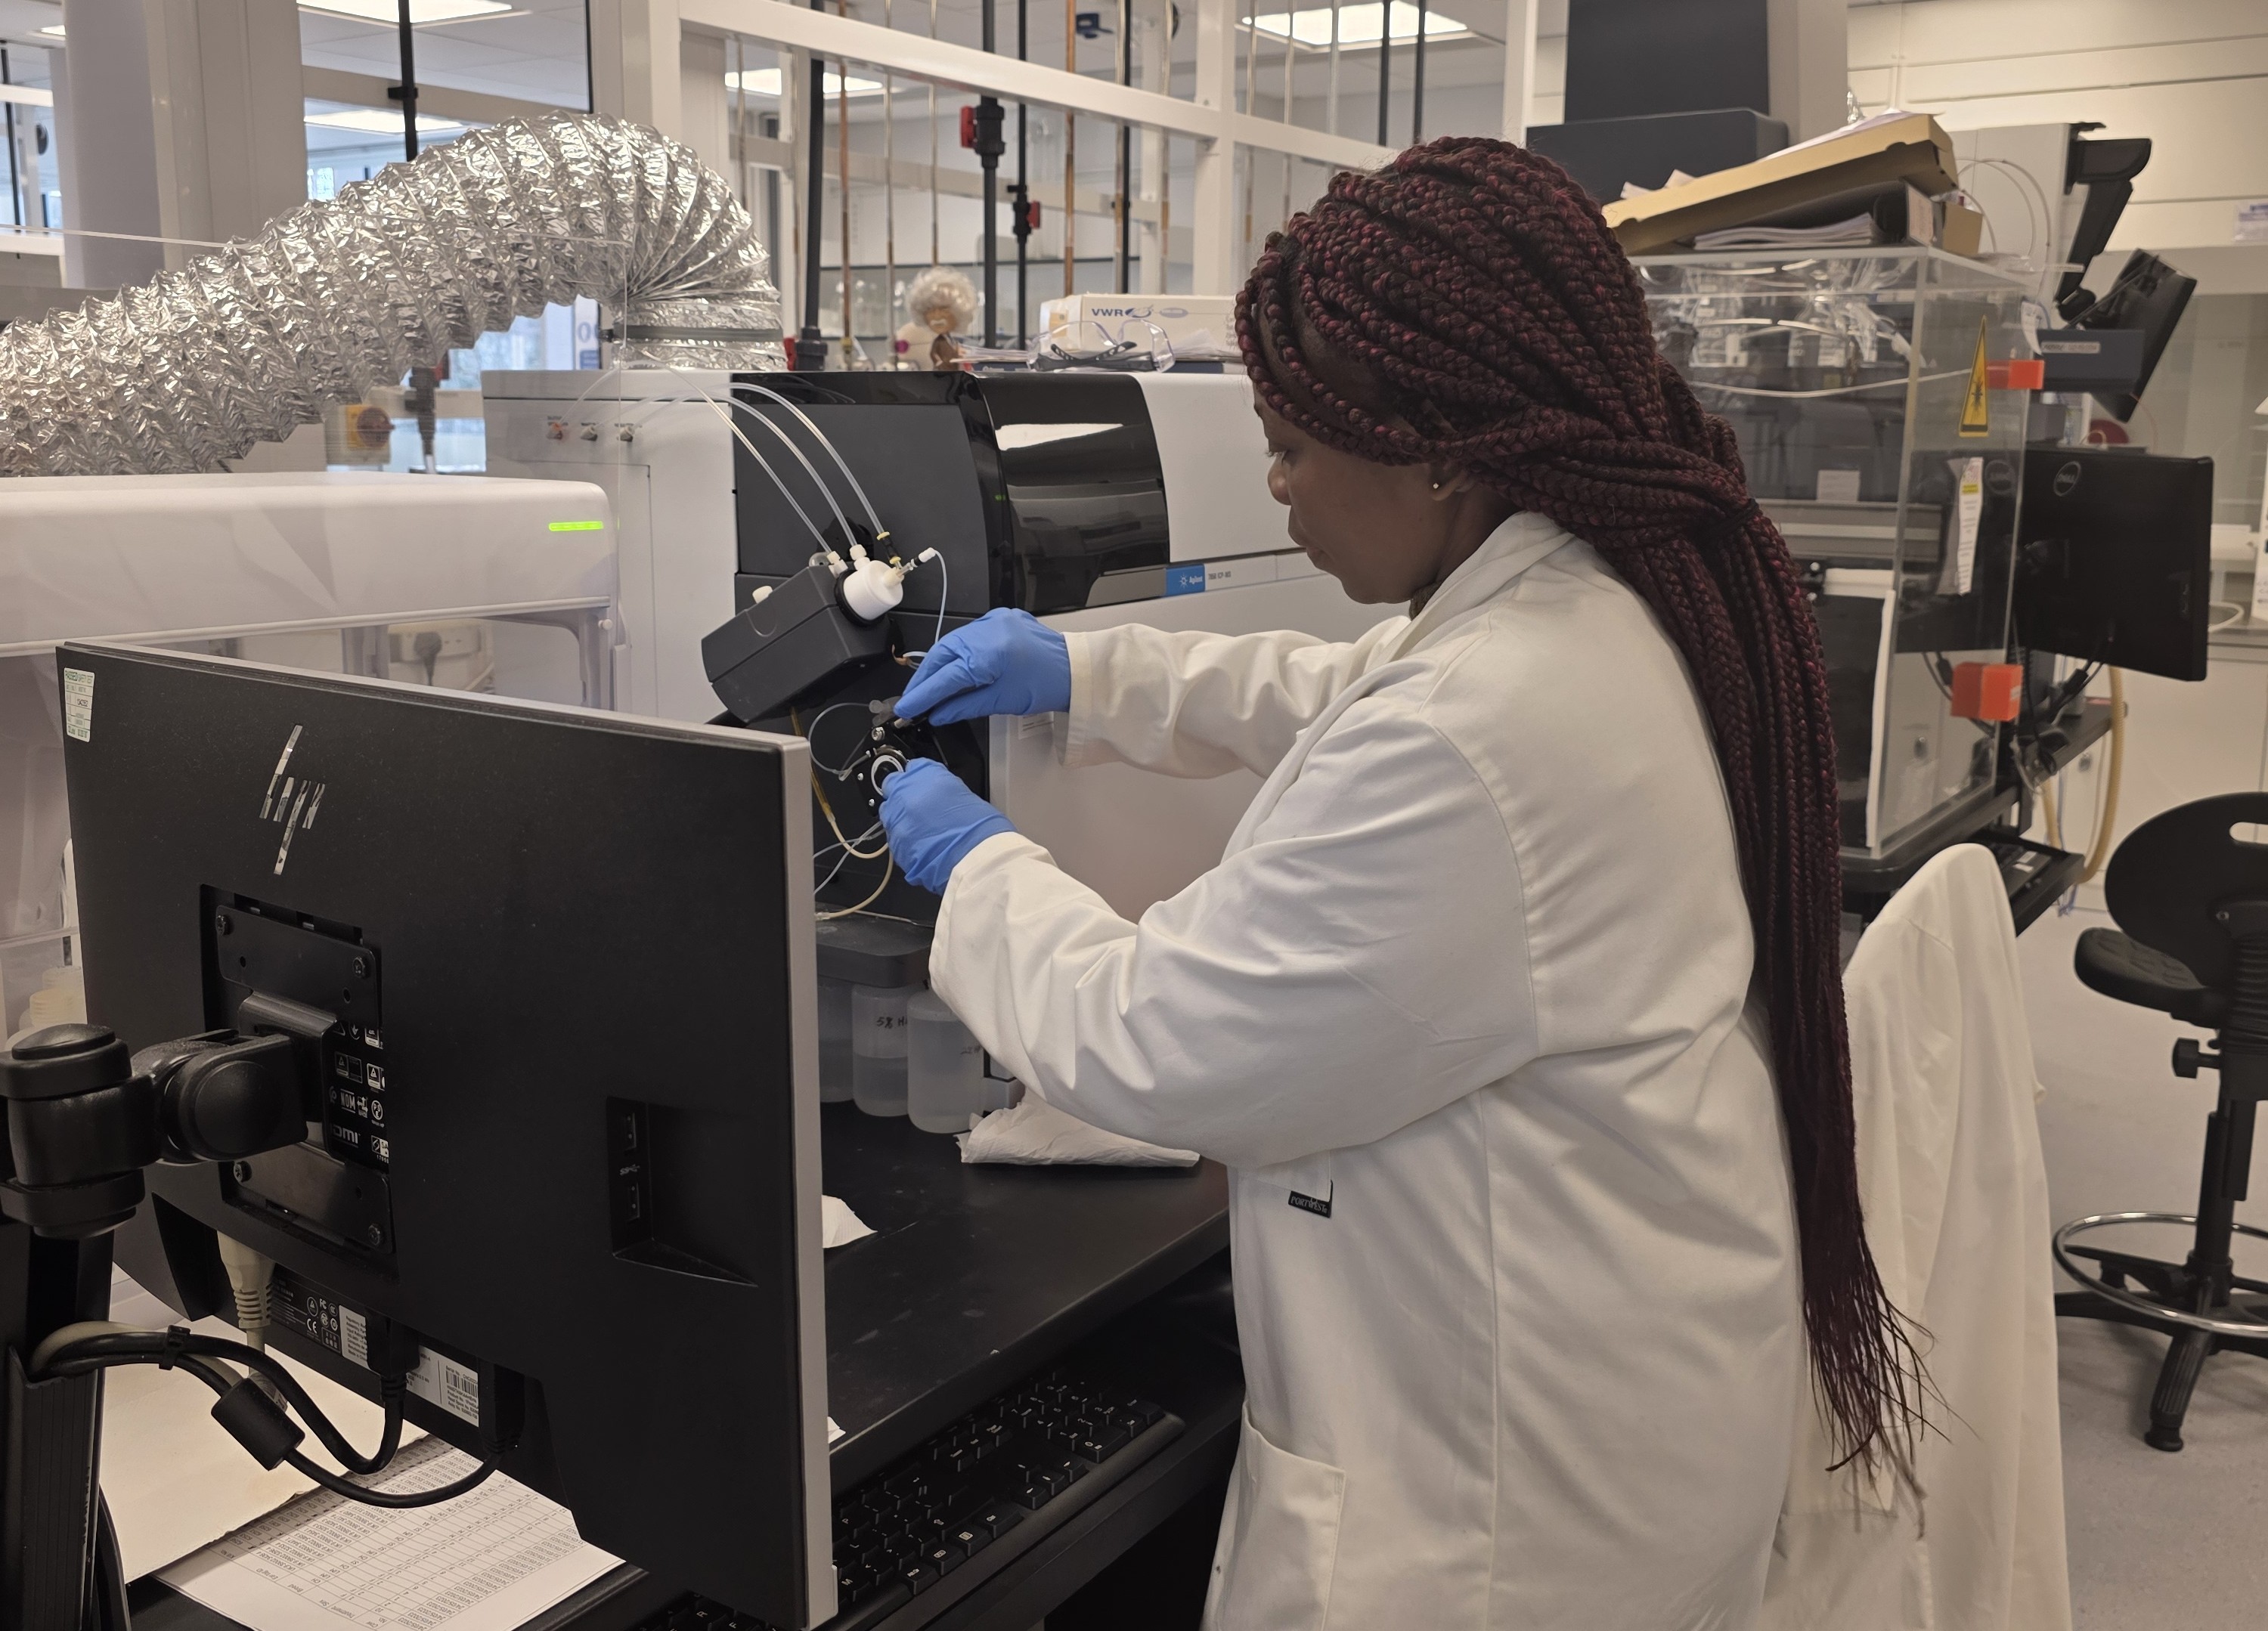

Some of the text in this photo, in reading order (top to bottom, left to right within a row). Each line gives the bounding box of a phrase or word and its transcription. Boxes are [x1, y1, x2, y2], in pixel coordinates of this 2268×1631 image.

[1092, 308, 1124, 317] VWR
[1188, 575, 1204, 585] Agilent
[340, 1091, 356, 1110] NOM
[1290, 1196, 1327, 1214] PORTWEST
[306, 1318, 318, 1334] CE
[354, 1515, 369, 1524] 39002
[362, 1511, 378, 1519] 39002
[336, 1525, 351, 1534] 39002
[345, 1520, 360, 1529] 39002
[318, 1534, 333, 1543] 39002
[327, 1530, 342, 1539] 39002
[299, 1544, 314, 1552] 39002
[308, 1540, 324, 1548] 39002
[541, 1541, 569, 1553] 31/05/2023
[290, 1549, 305, 1558] 39002
[525, 1550, 552, 1562] 31/05/2023
[533, 1546, 561, 1558] 31/05/2023
[507, 1559, 535, 1571] 31/05/2023
[516, 1555, 544, 1566] 31/05/2023
[490, 1568, 519, 1580] 24/05/2023
[499, 1563, 527, 1575] 24/05/2023
[472, 1577, 500, 1589] 24/05/2023
[481, 1572, 510, 1585] 24/05/2023
[454, 1586, 482, 1599] 24/05/2023
[463, 1581, 491, 1595] 24/05/2023
[435, 1596, 464, 1609] 24/05/2023
[445, 1591, 473, 1605] 24/05/2023
[417, 1608, 445, 1620] 24/05/2023
[426, 1602, 455, 1615] 24/05/2023
[696, 1610, 708, 1618] R
[398, 1617, 426, 1631] 24/05/2023
[407, 1612, 436, 1626] 24/05/2023
